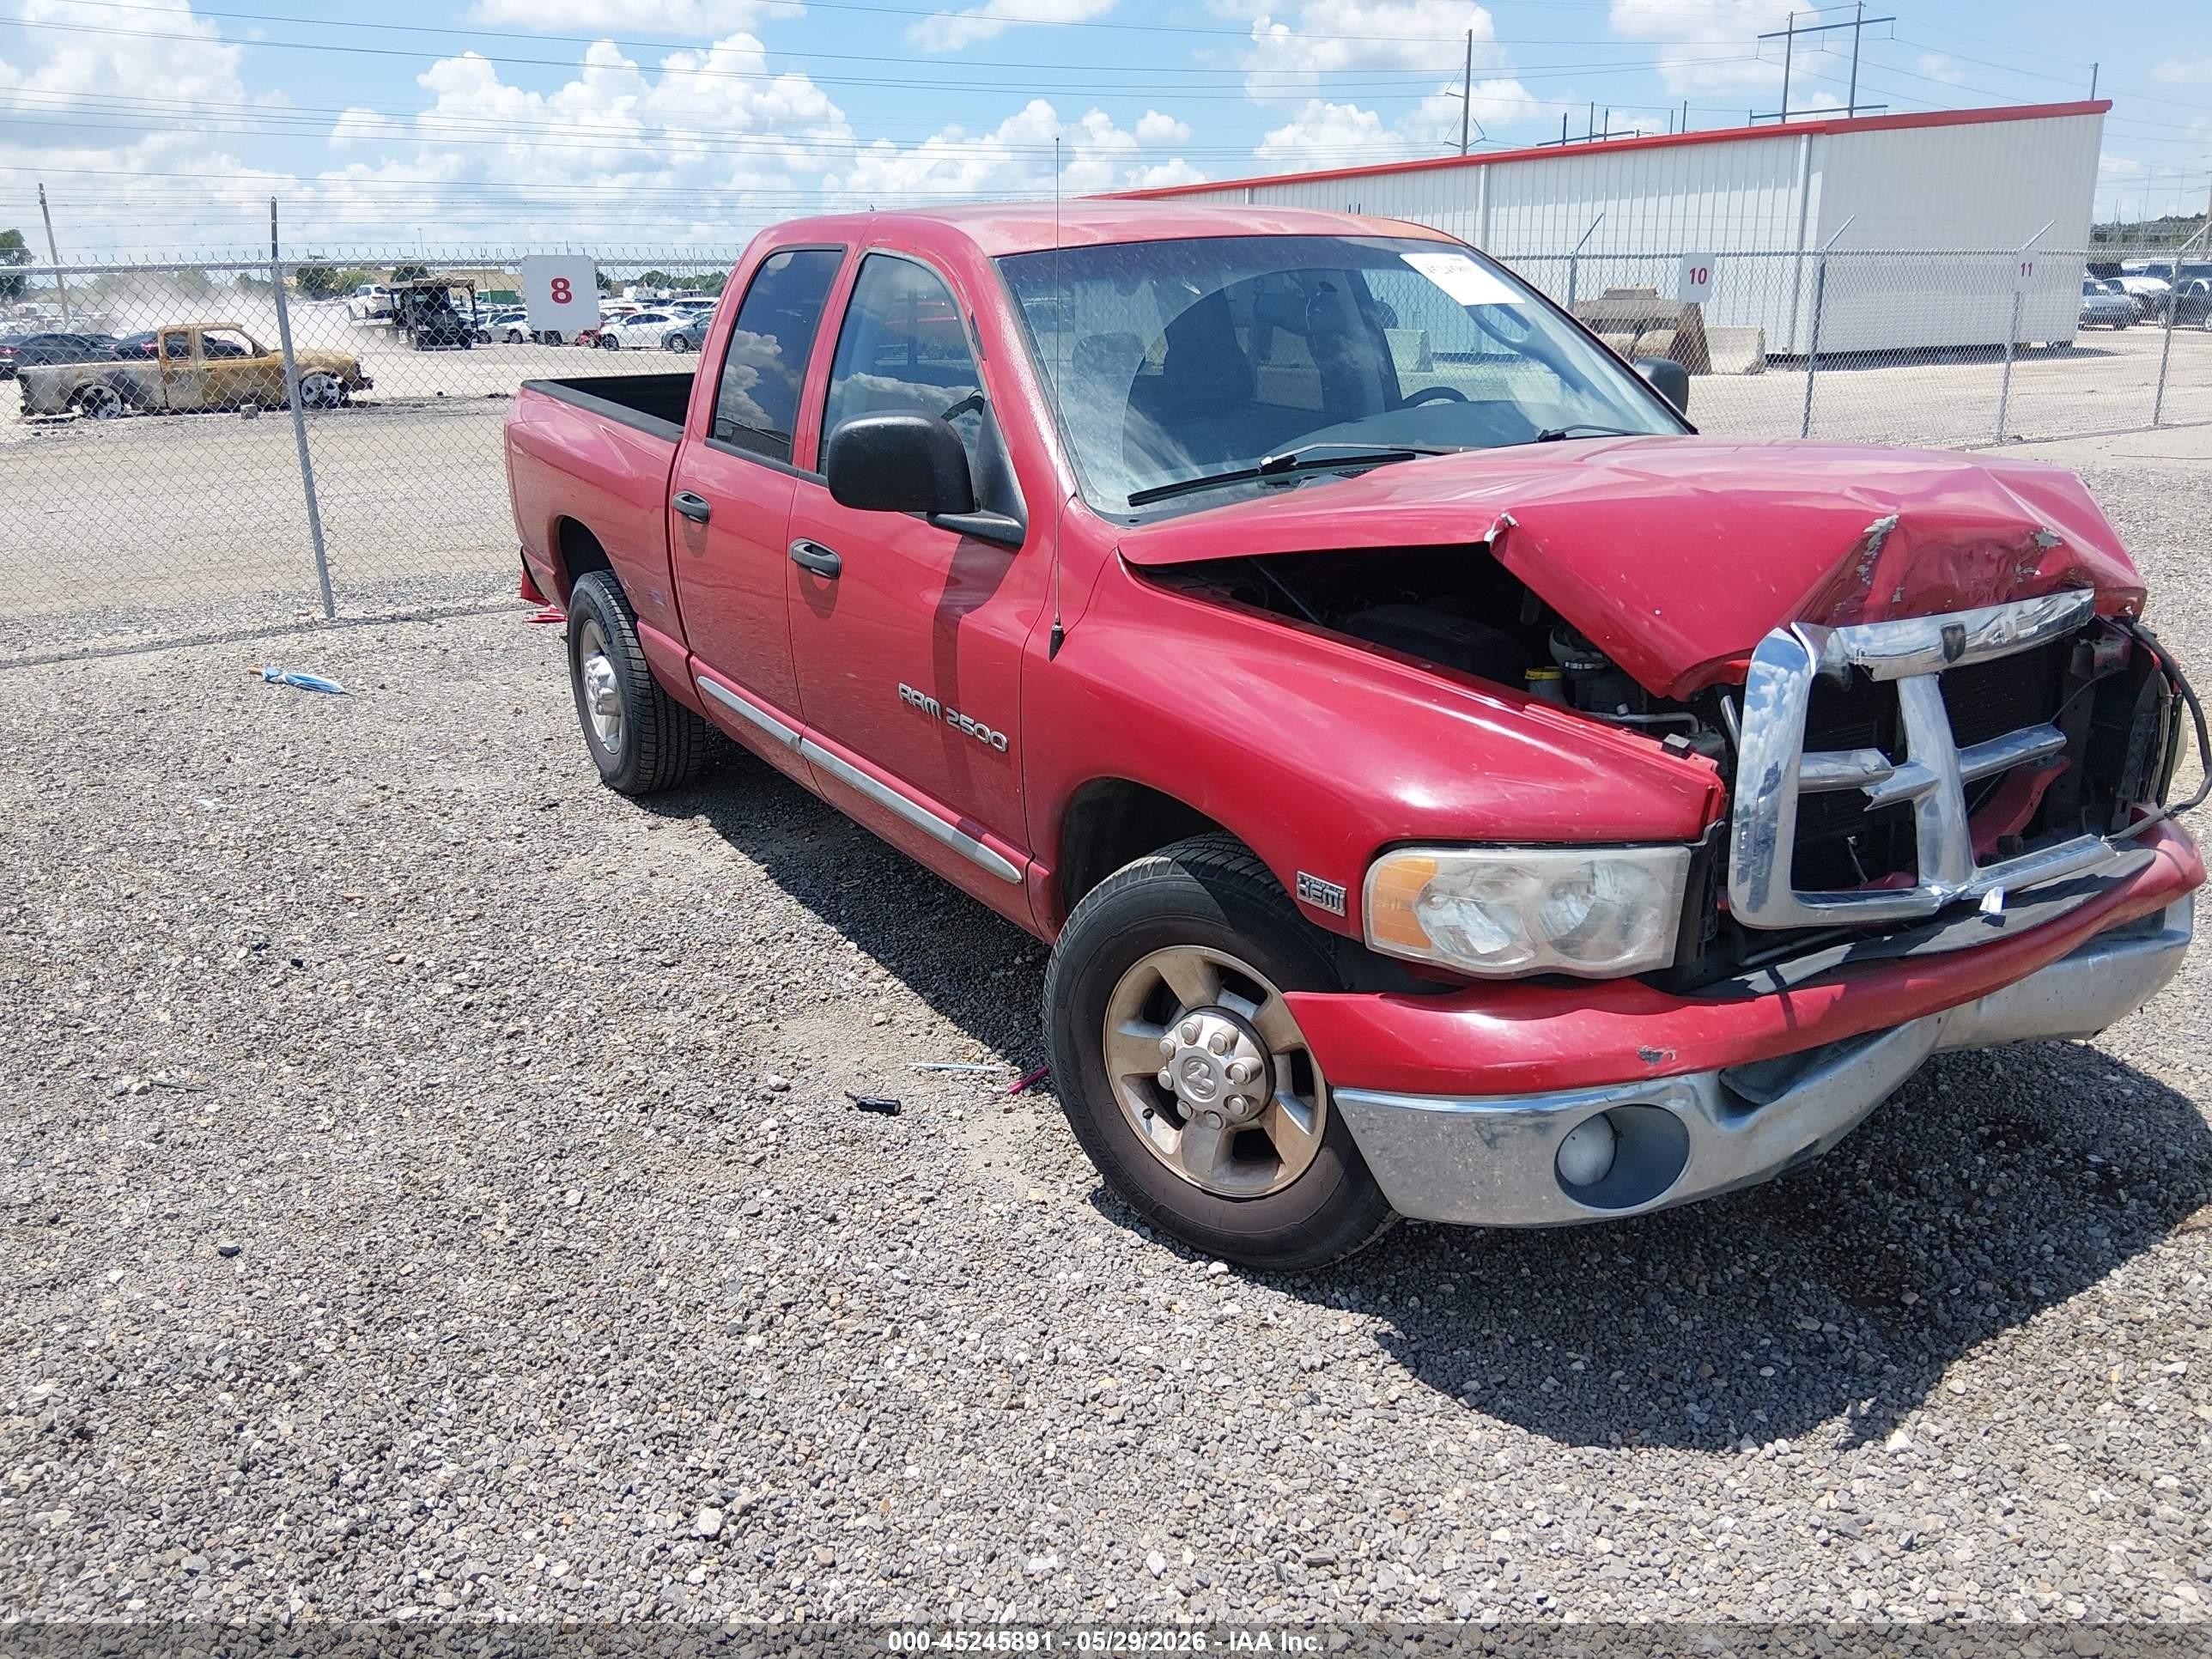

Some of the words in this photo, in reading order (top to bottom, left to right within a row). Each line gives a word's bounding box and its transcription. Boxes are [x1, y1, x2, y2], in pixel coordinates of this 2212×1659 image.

[1689, 267, 1708, 285] 10
[2021, 262, 2033, 276] 11
[550, 277, 573, 304] 8
[898, 682, 942, 720] RAM
[945, 707, 1008, 752] 2500
[1297, 872, 1346, 915] HEMI
